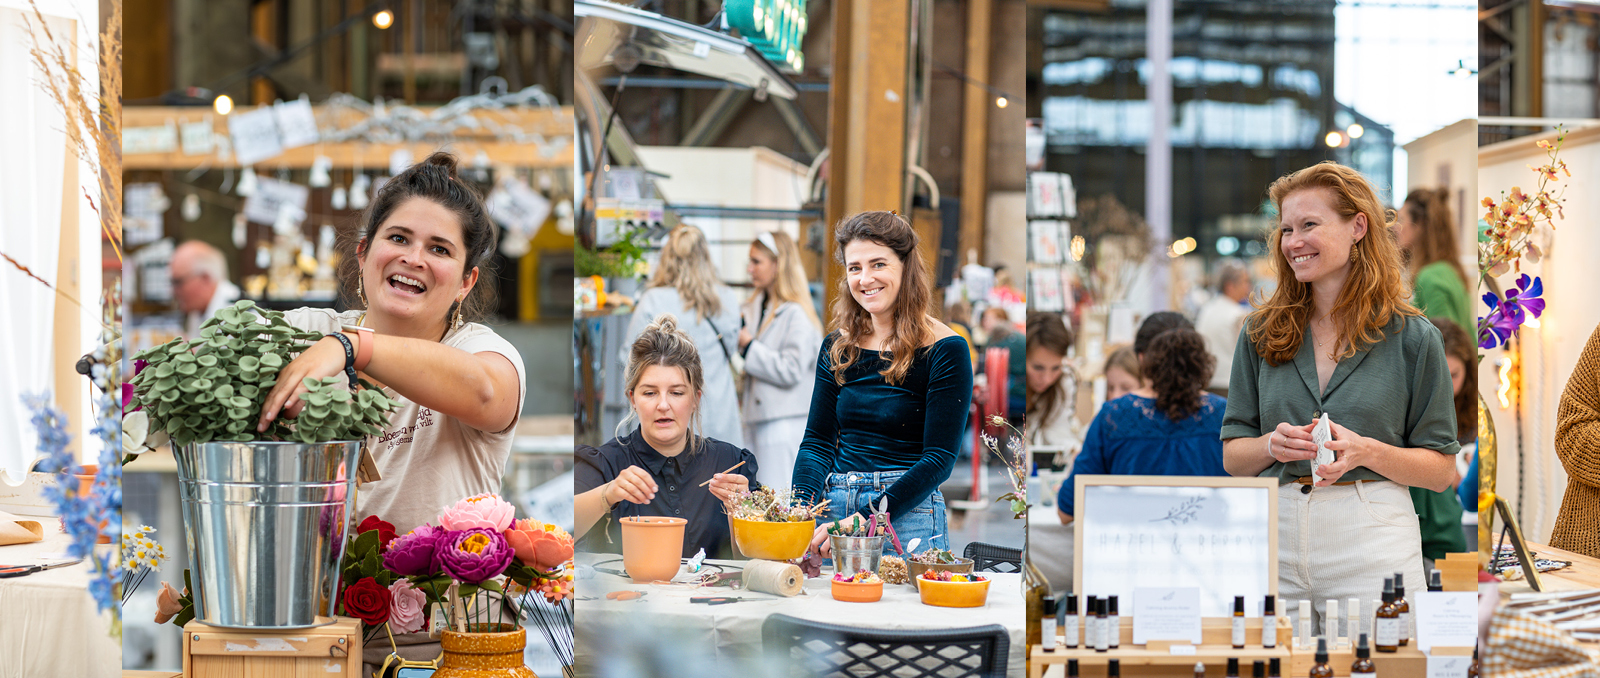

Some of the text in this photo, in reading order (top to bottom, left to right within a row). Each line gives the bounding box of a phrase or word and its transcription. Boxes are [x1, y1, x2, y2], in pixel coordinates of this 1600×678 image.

[420, 417, 433, 427] vilt
[1100, 532, 1255, 555] HAZEL & BERRY
